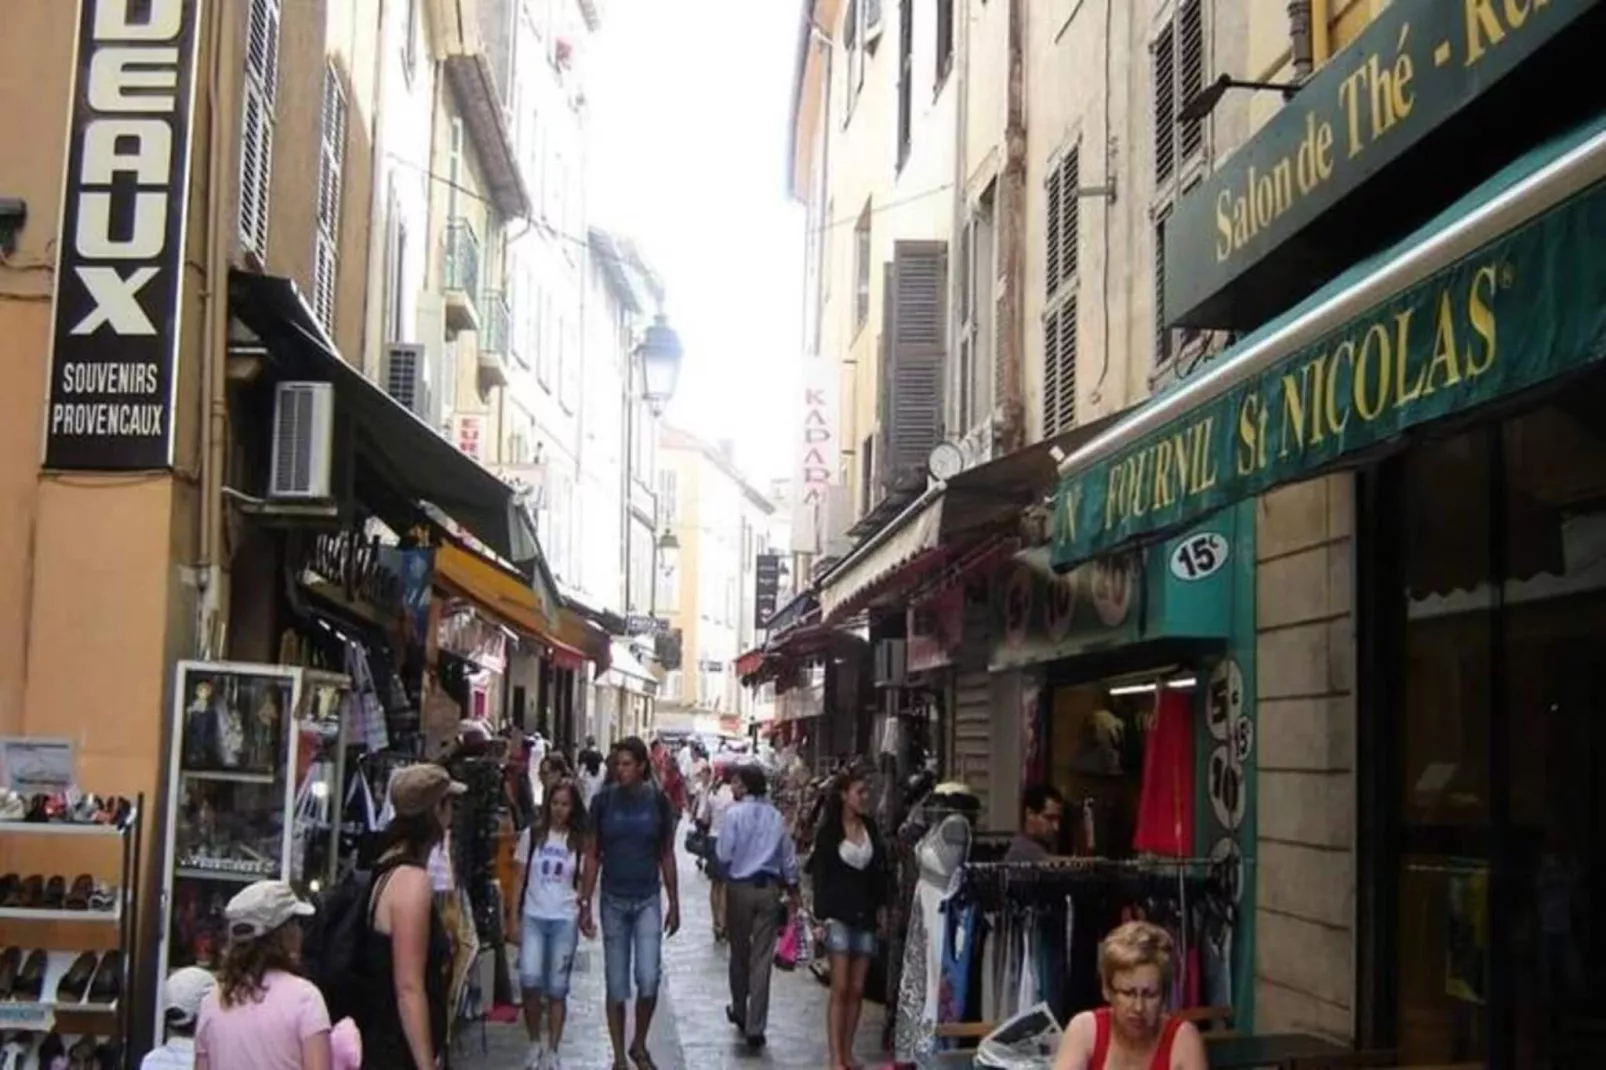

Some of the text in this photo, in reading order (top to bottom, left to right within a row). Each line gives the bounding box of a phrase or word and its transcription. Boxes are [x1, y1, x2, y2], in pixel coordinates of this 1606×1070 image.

[69, 0, 184, 336] DEAUX
[1216, 158, 1293, 263] Salon
[1297, 111, 1333, 196] de
[1339, 22, 1416, 160] Thé
[52, 402, 163, 438] PROVENCAUX
[62, 362, 158, 395] SOUVENIRS
[1104, 415, 1218, 530] FOURNIL
[1236, 393, 1267, 476] St
[1278, 264, 1497, 459] NICOLAS
